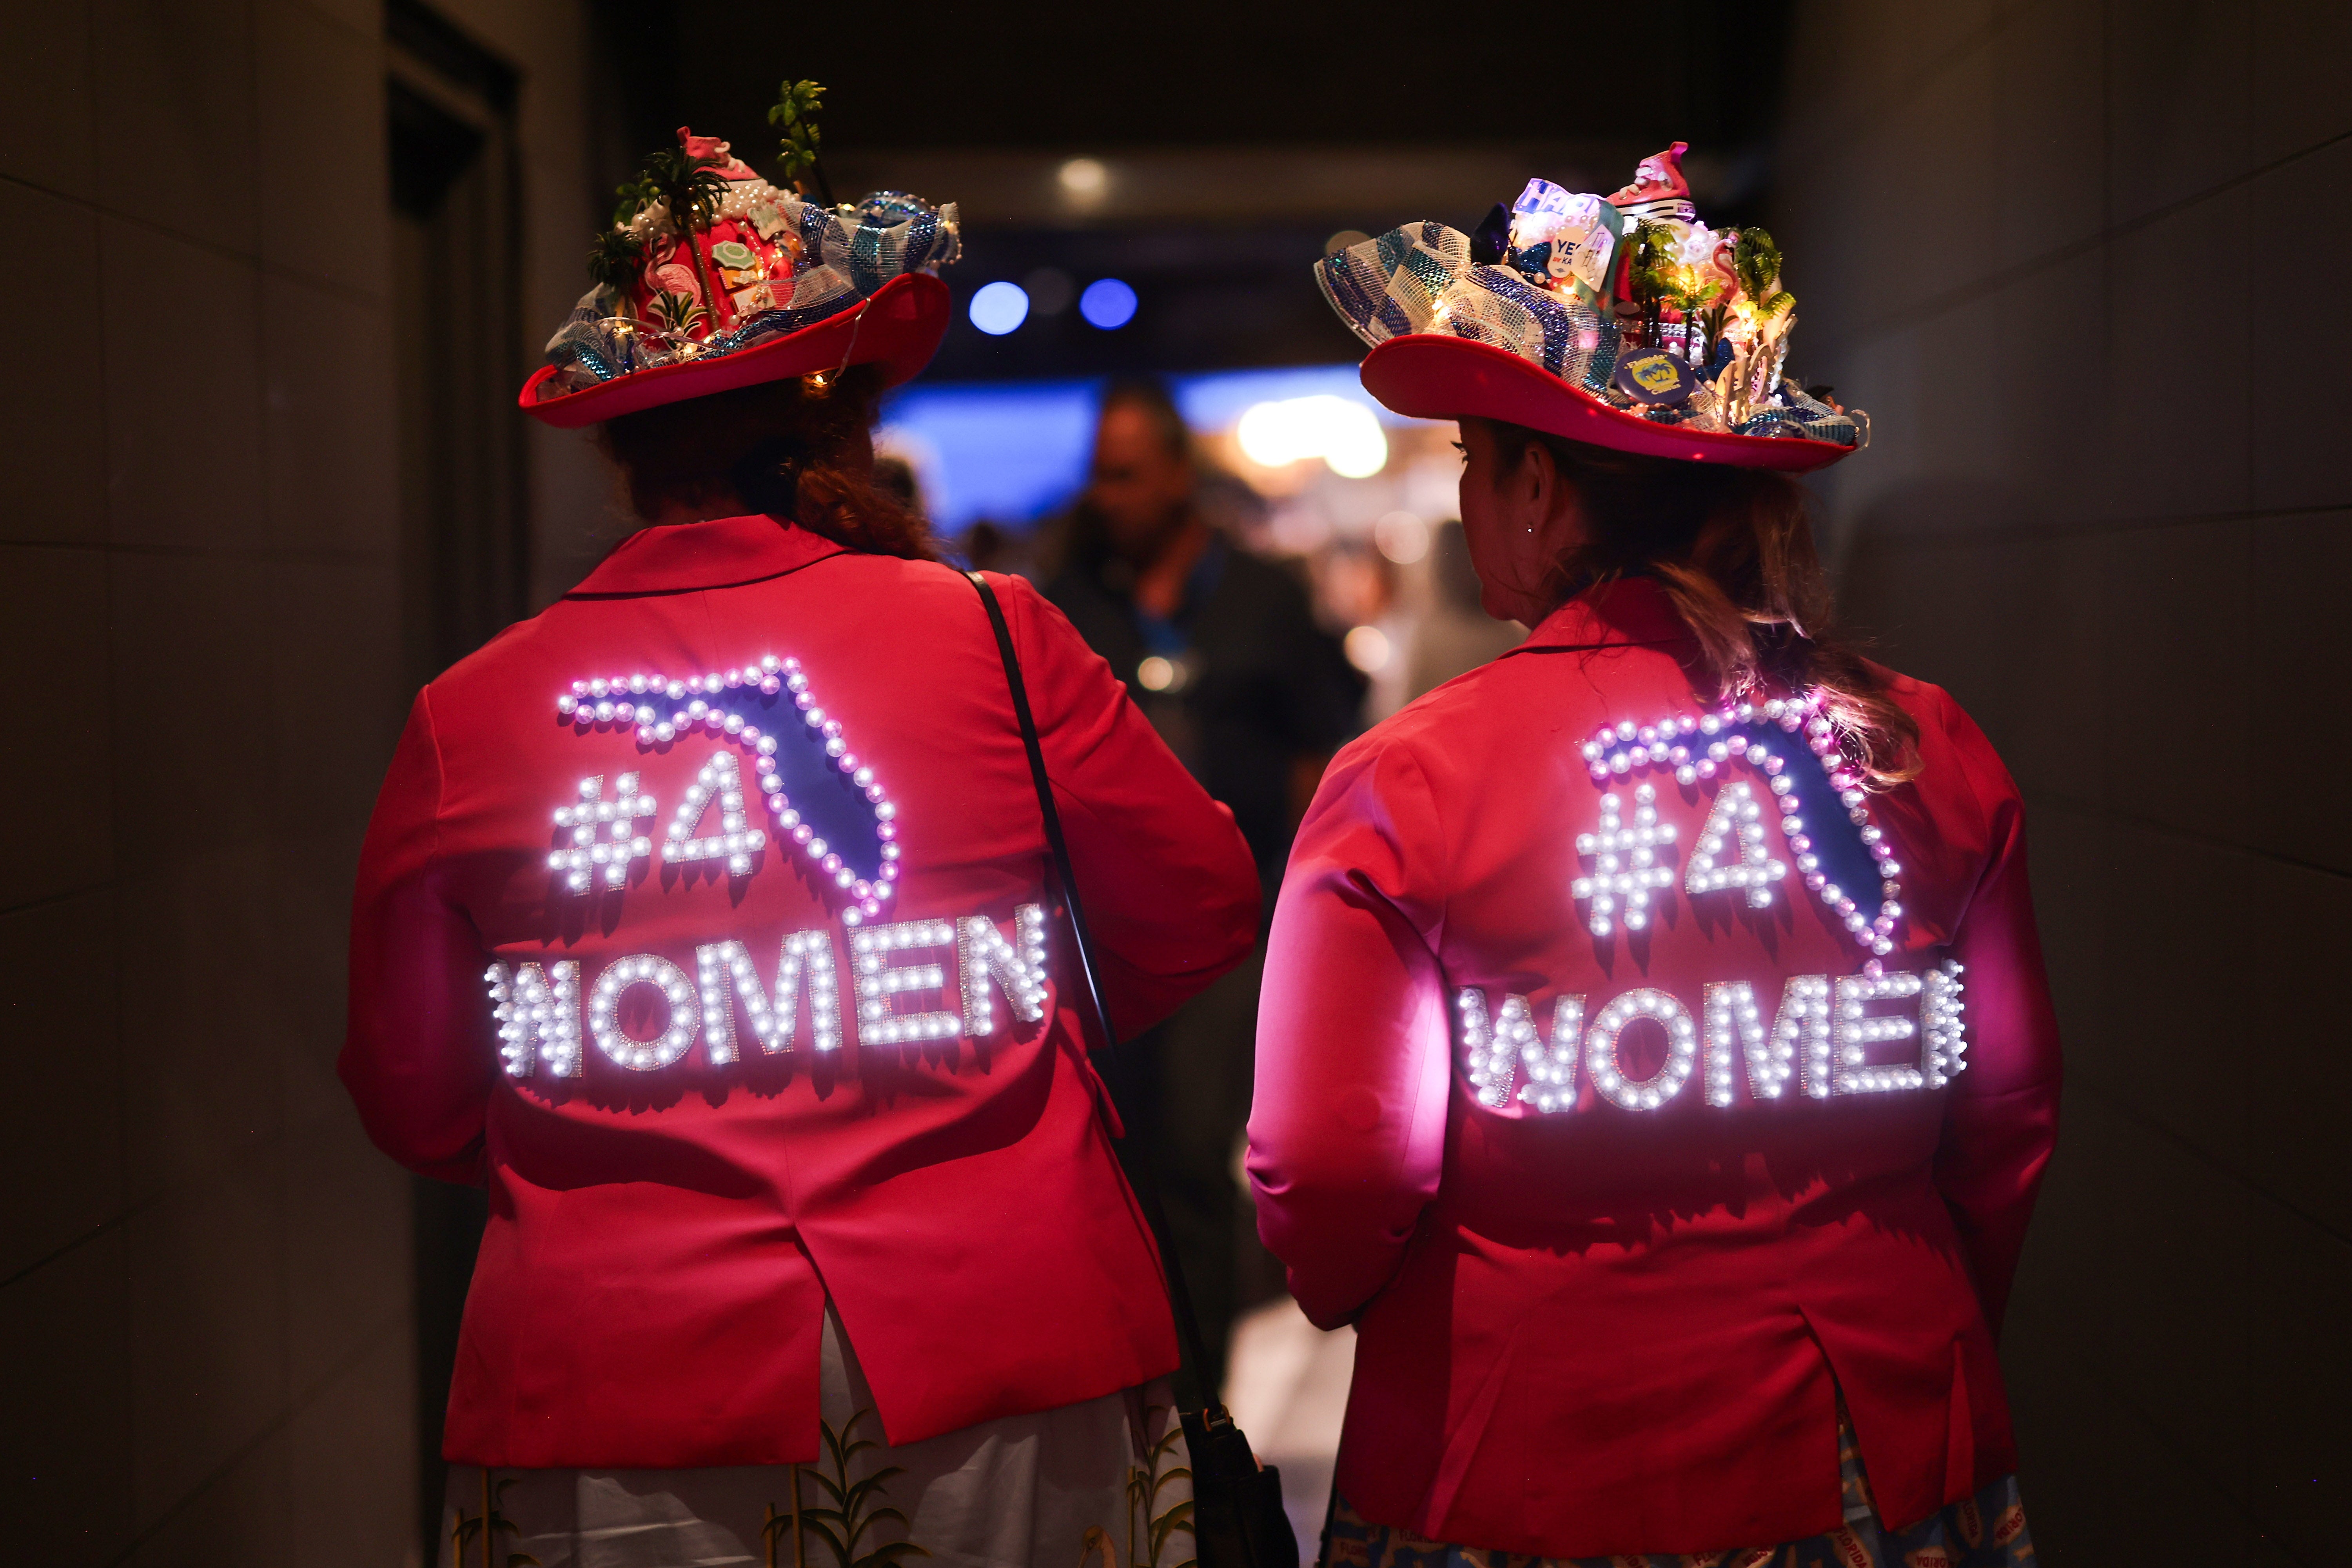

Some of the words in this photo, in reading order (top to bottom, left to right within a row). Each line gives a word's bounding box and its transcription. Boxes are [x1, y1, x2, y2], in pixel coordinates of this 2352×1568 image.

[549, 751, 766, 897] #4
[1571, 781, 1786, 936] #4
[484, 904, 1047, 1077] WOMEN
